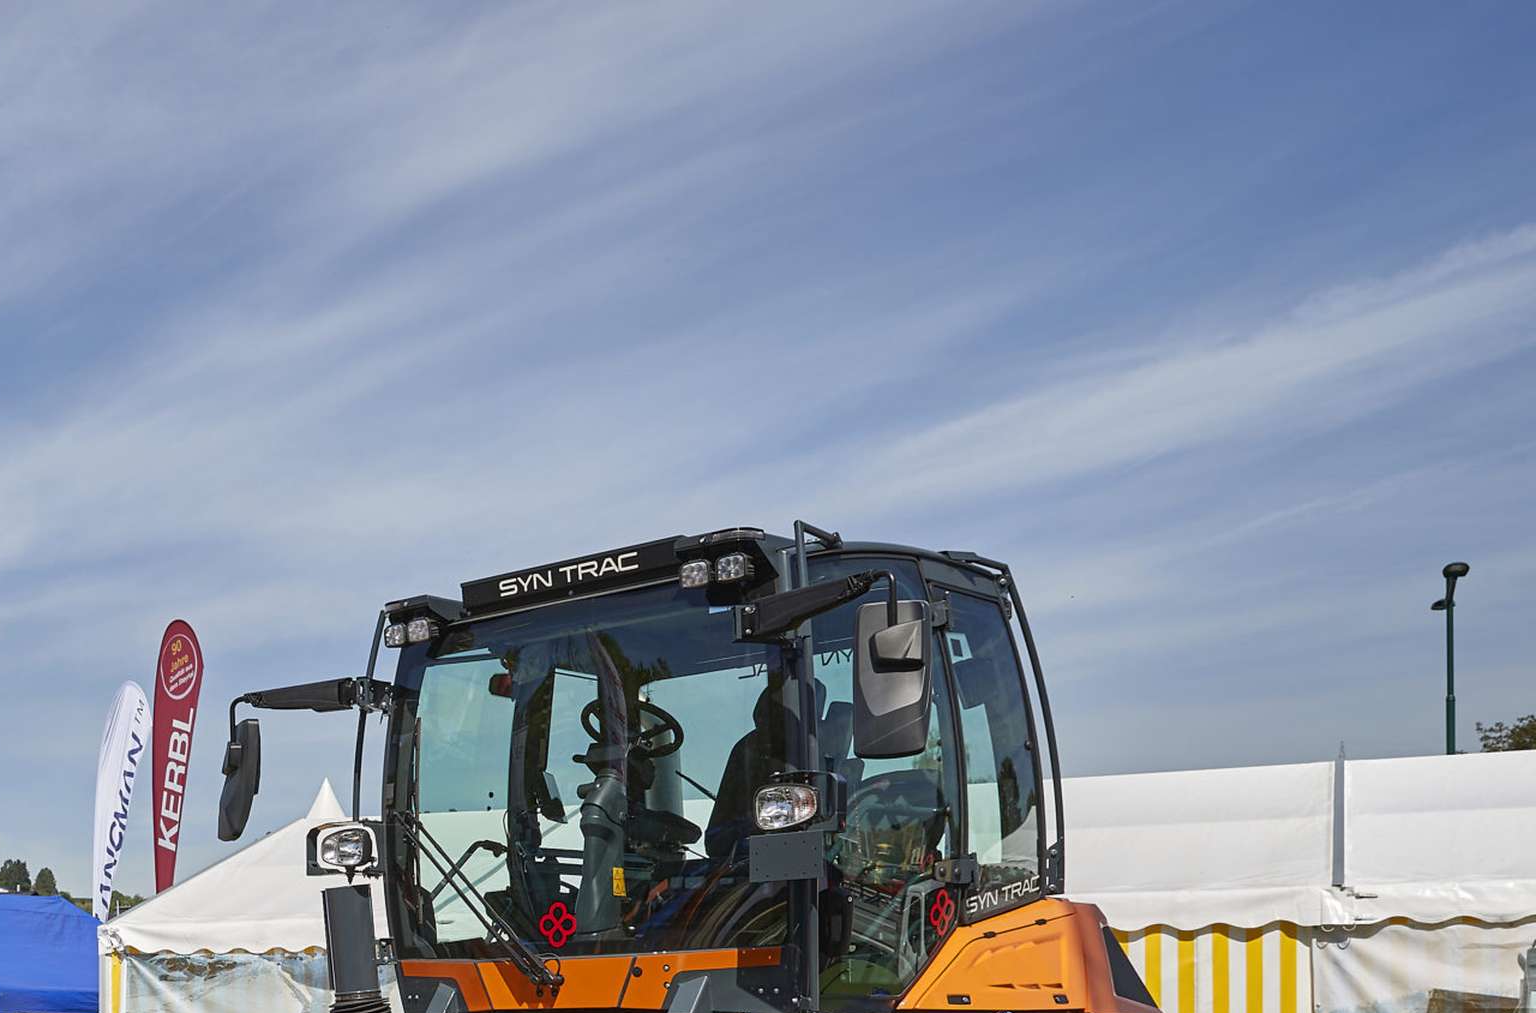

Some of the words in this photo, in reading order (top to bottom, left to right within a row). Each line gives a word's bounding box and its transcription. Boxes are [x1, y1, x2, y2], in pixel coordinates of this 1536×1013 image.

[498, 570, 553, 598] SYN
[558, 551, 640, 584] TRAC
[158, 707, 194, 852] KERBL
[965, 888, 999, 914] SYN
[1001, 874, 1041, 902] TRAC
